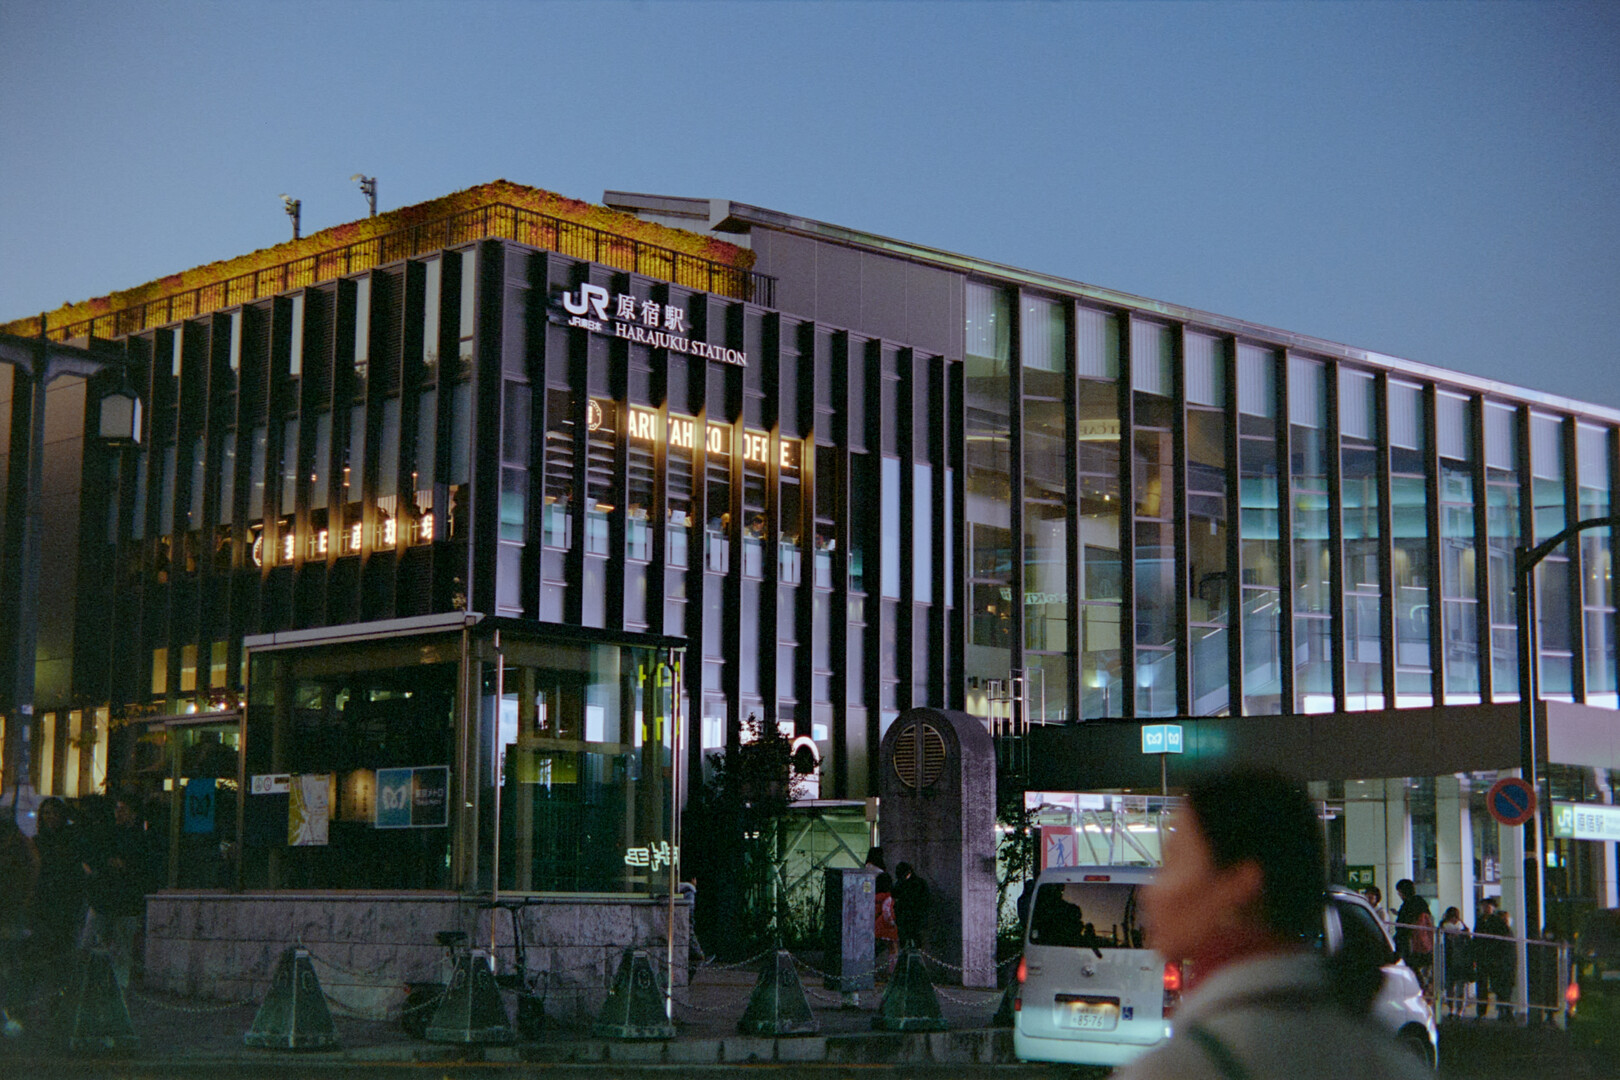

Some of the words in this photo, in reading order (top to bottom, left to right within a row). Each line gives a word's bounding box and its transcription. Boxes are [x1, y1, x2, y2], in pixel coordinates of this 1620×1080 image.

[563, 282, 609, 321] JR
[616, 293, 685, 332] 原宿駅
[568, 316, 602, 332] JR東日本
[615, 322, 690, 352] HARAJUKU
[691, 340, 748, 367] STATION
[1557, 808, 1572, 827] JR
